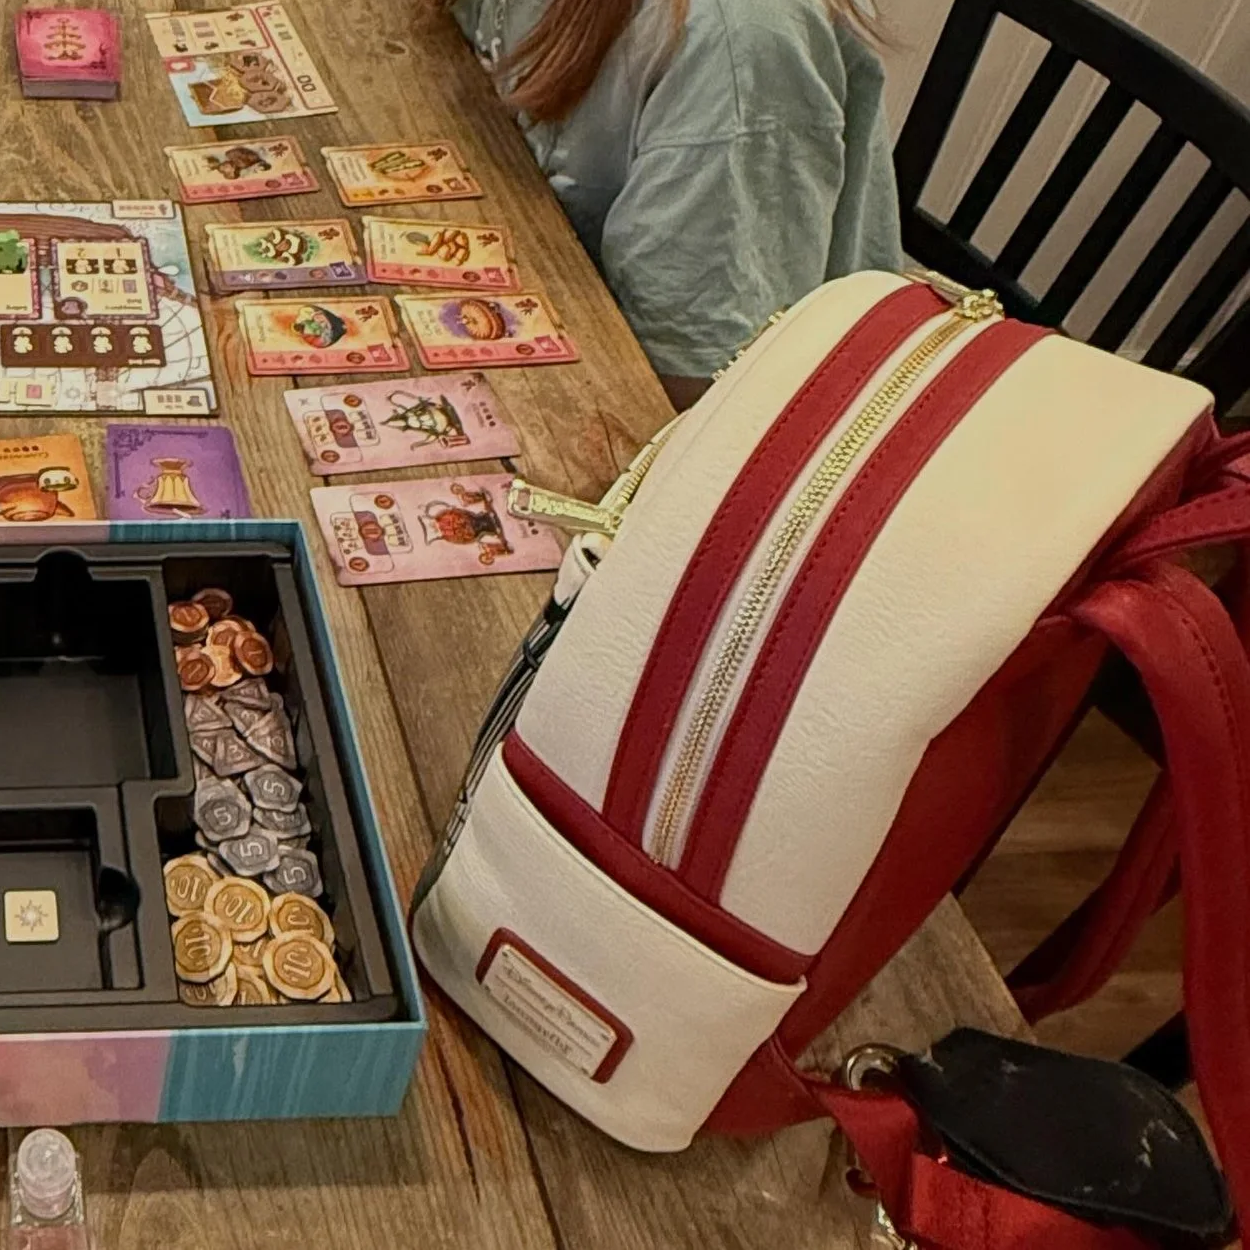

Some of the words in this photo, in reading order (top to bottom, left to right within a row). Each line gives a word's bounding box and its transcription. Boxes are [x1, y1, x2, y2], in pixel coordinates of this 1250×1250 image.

[263, 779, 285, 797] 5
[213, 807, 231, 825] 5
[240, 841, 263, 857] 5
[283, 866, 307, 885] 5
[177, 875, 203, 900] 10
[225, 896, 251, 924] 10
